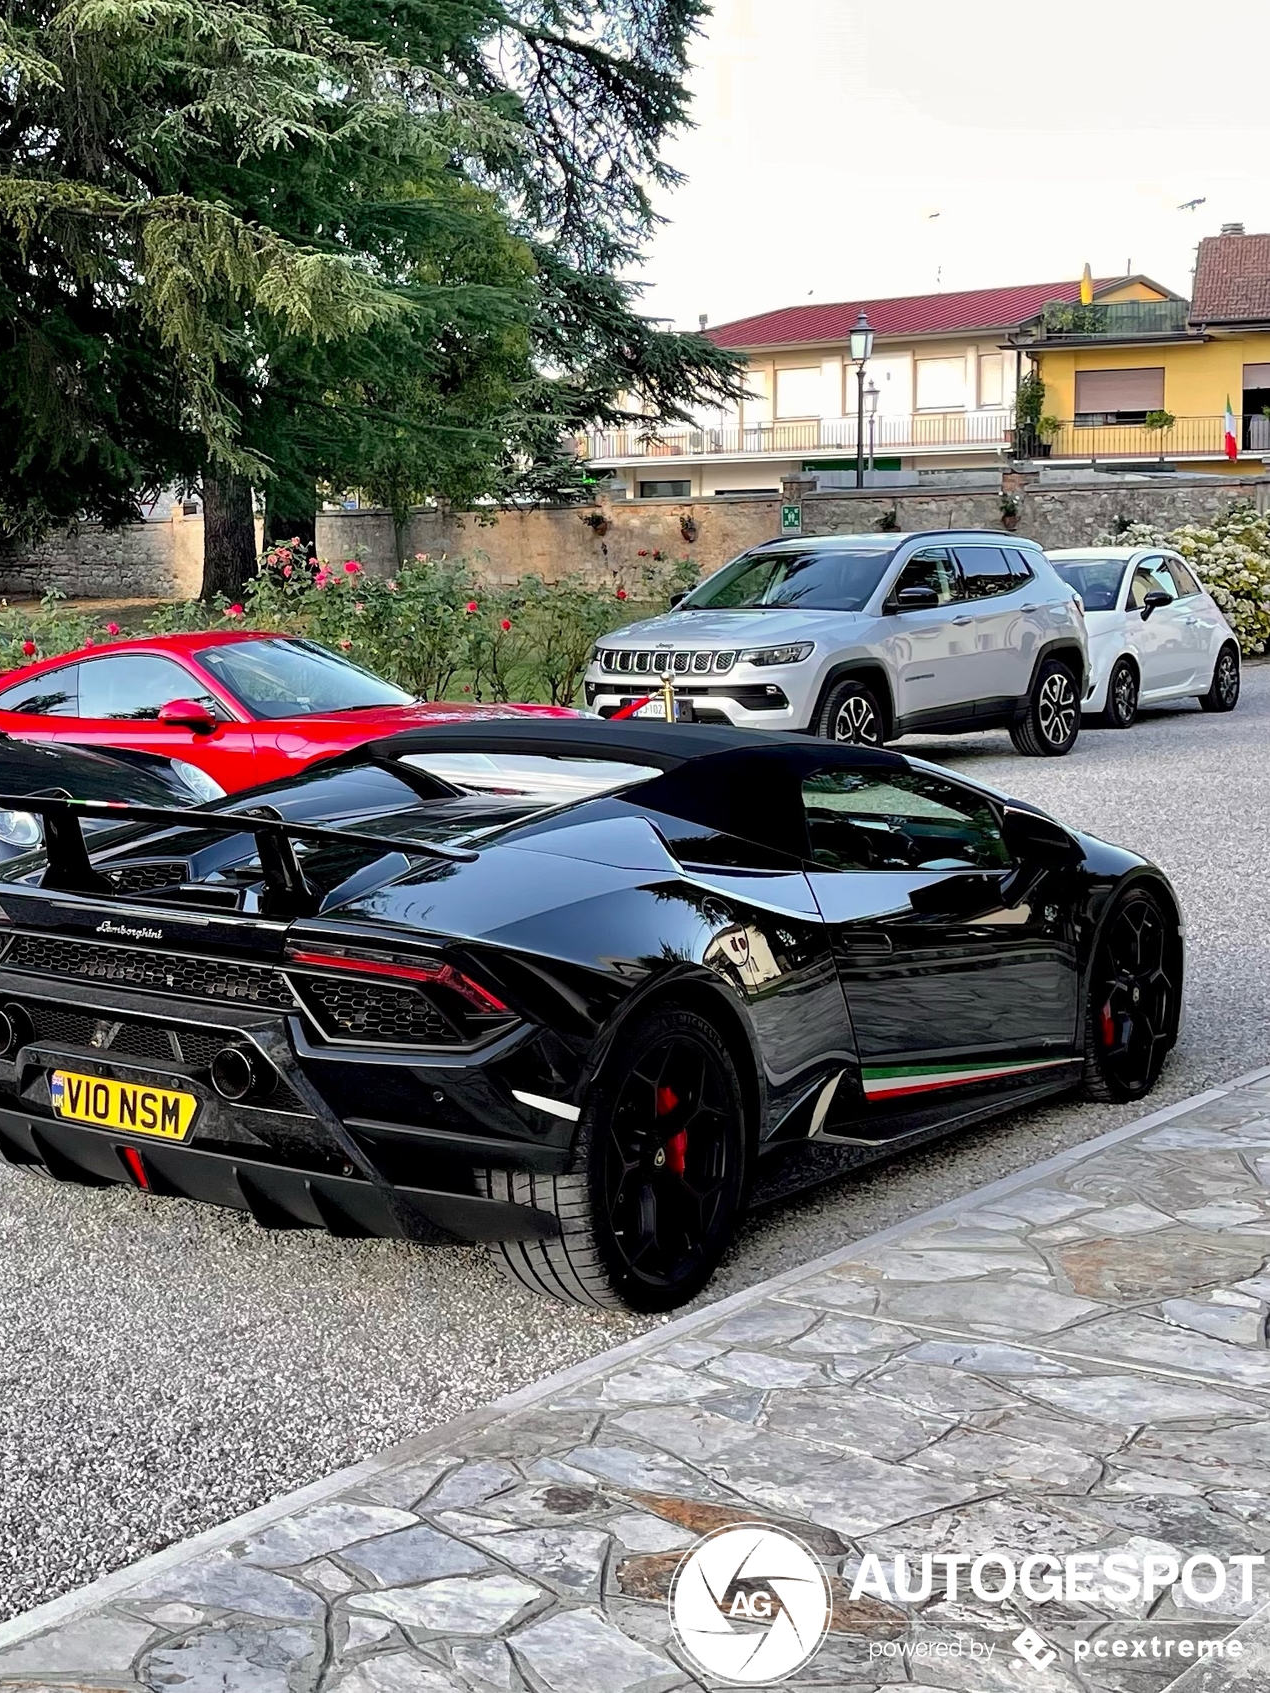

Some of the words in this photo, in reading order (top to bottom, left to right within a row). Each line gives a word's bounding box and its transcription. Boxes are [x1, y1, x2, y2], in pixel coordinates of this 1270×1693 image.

[96, 920, 163, 939] Lamborghini
[679, 1014, 723, 1049] MICHELIN
[52, 1093, 64, 1107] UK
[67, 1077, 109, 1120] V10
[119, 1087, 180, 1134] NSM
